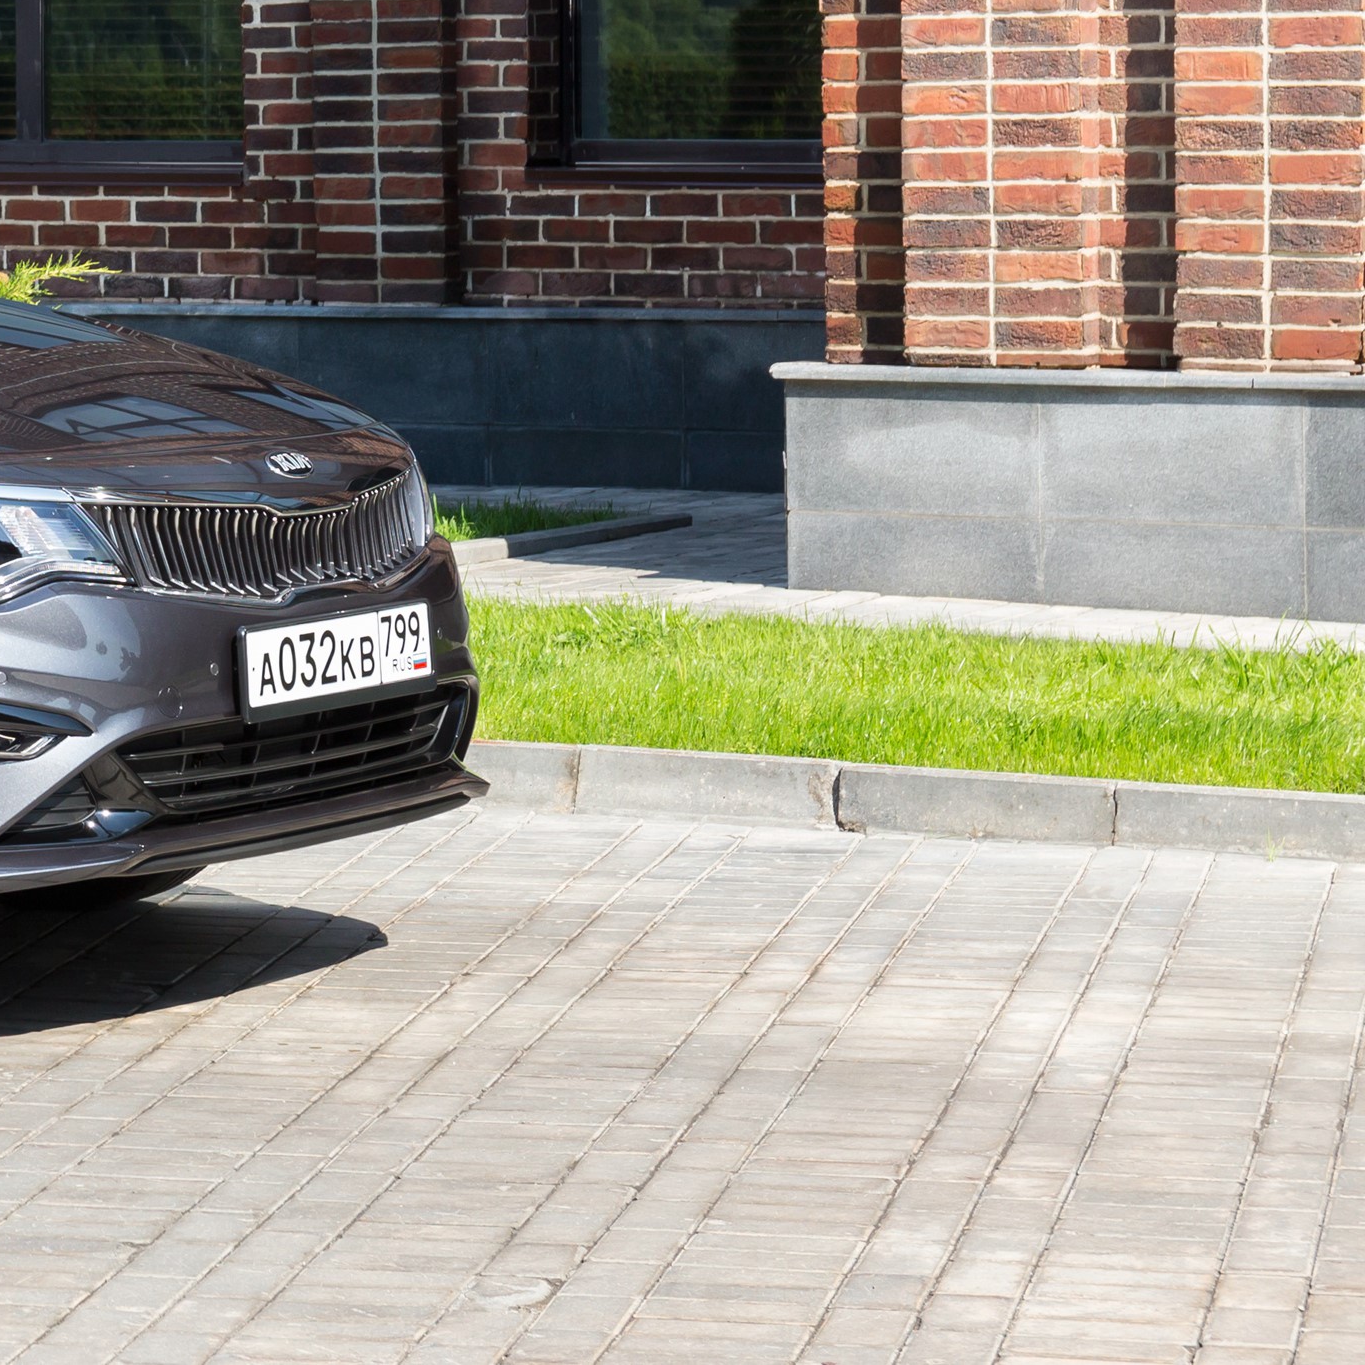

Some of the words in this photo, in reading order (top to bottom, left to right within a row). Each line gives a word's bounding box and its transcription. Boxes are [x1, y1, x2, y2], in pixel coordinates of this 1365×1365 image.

[270, 453, 312, 471] KIA
[259, 629, 375, 696] A032KB
[380, 611, 420, 657] 799
[392, 656, 412, 672] RUS
